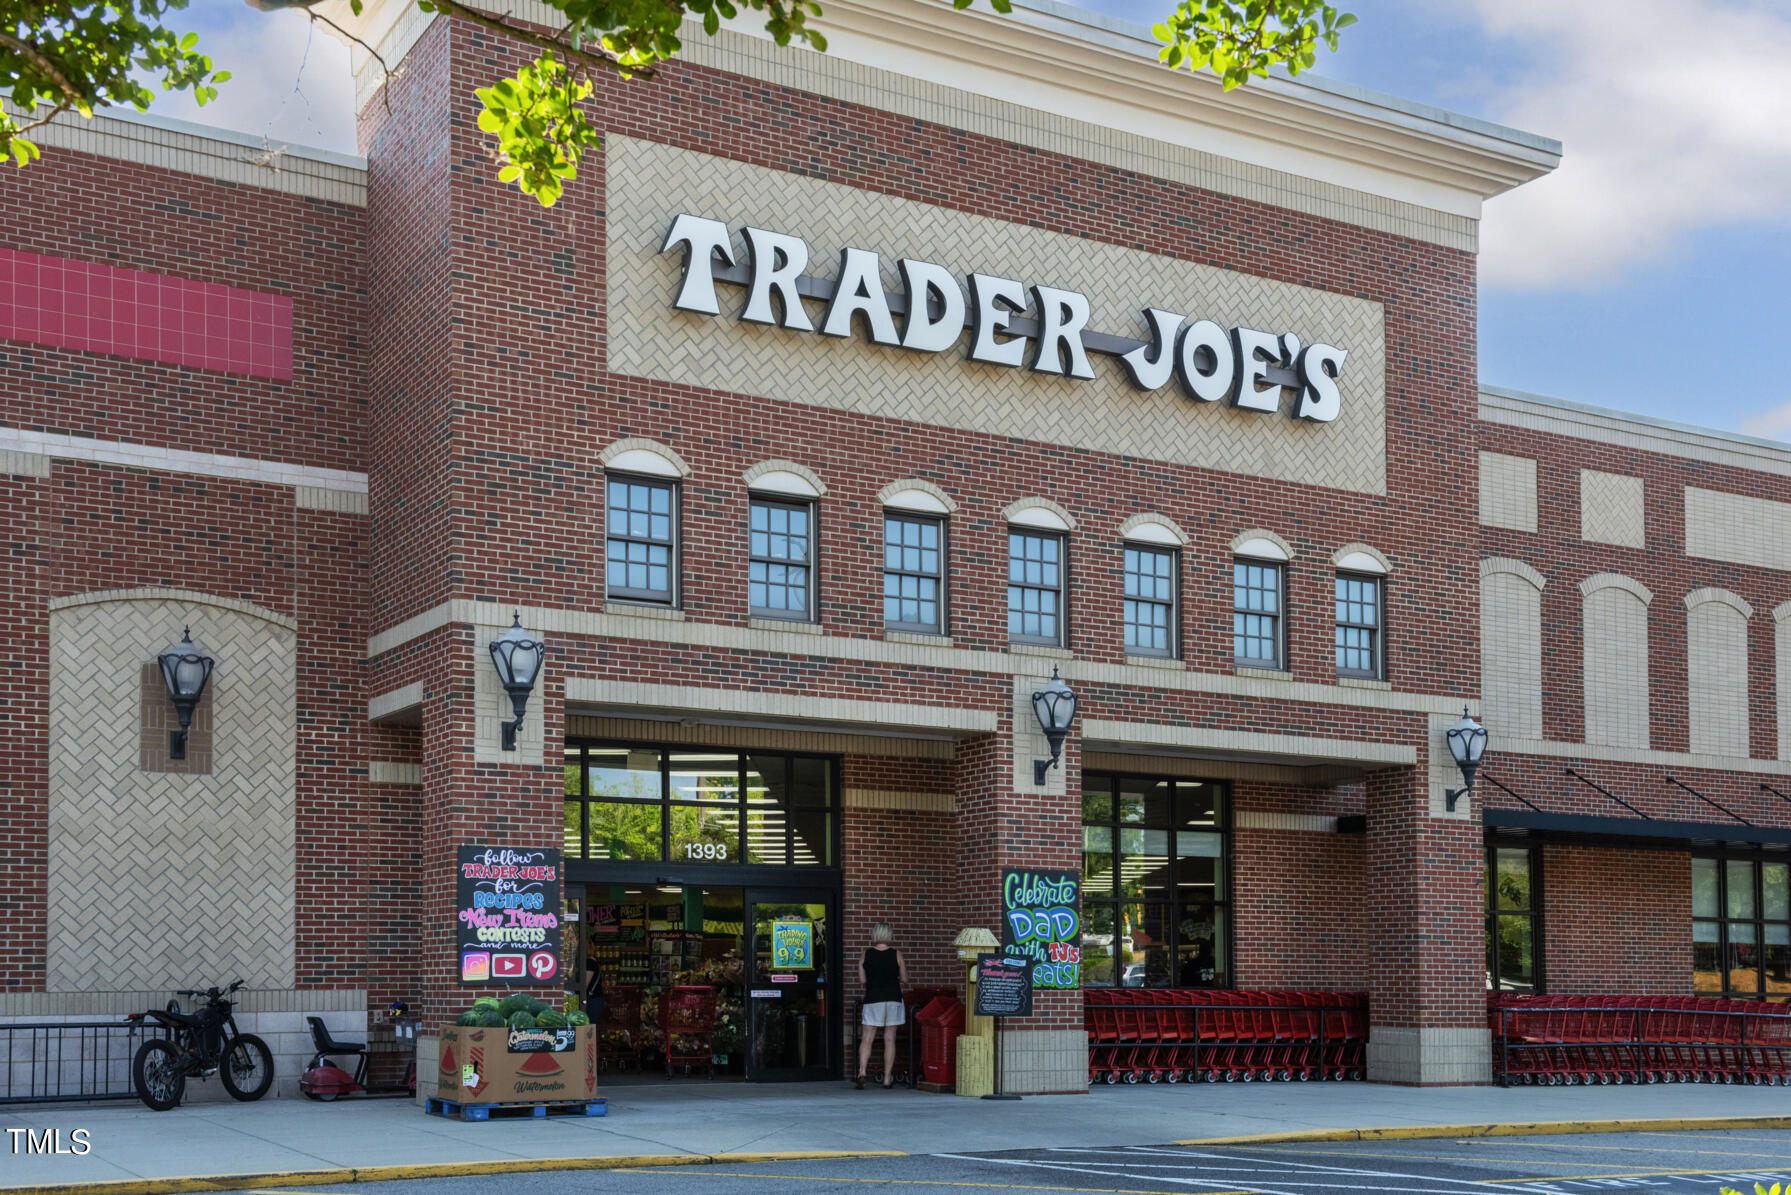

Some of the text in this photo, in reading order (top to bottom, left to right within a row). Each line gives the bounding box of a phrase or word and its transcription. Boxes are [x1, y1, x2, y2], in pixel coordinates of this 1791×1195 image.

[659, 212, 1349, 424] TRADER JOE'S
[479, 849, 539, 865] follow
[684, 843, 728, 860] 1393
[461, 863, 556, 881] TRADER JOE'S
[1004, 873, 1077, 909] Celebrate
[459, 907, 557, 929] New Items
